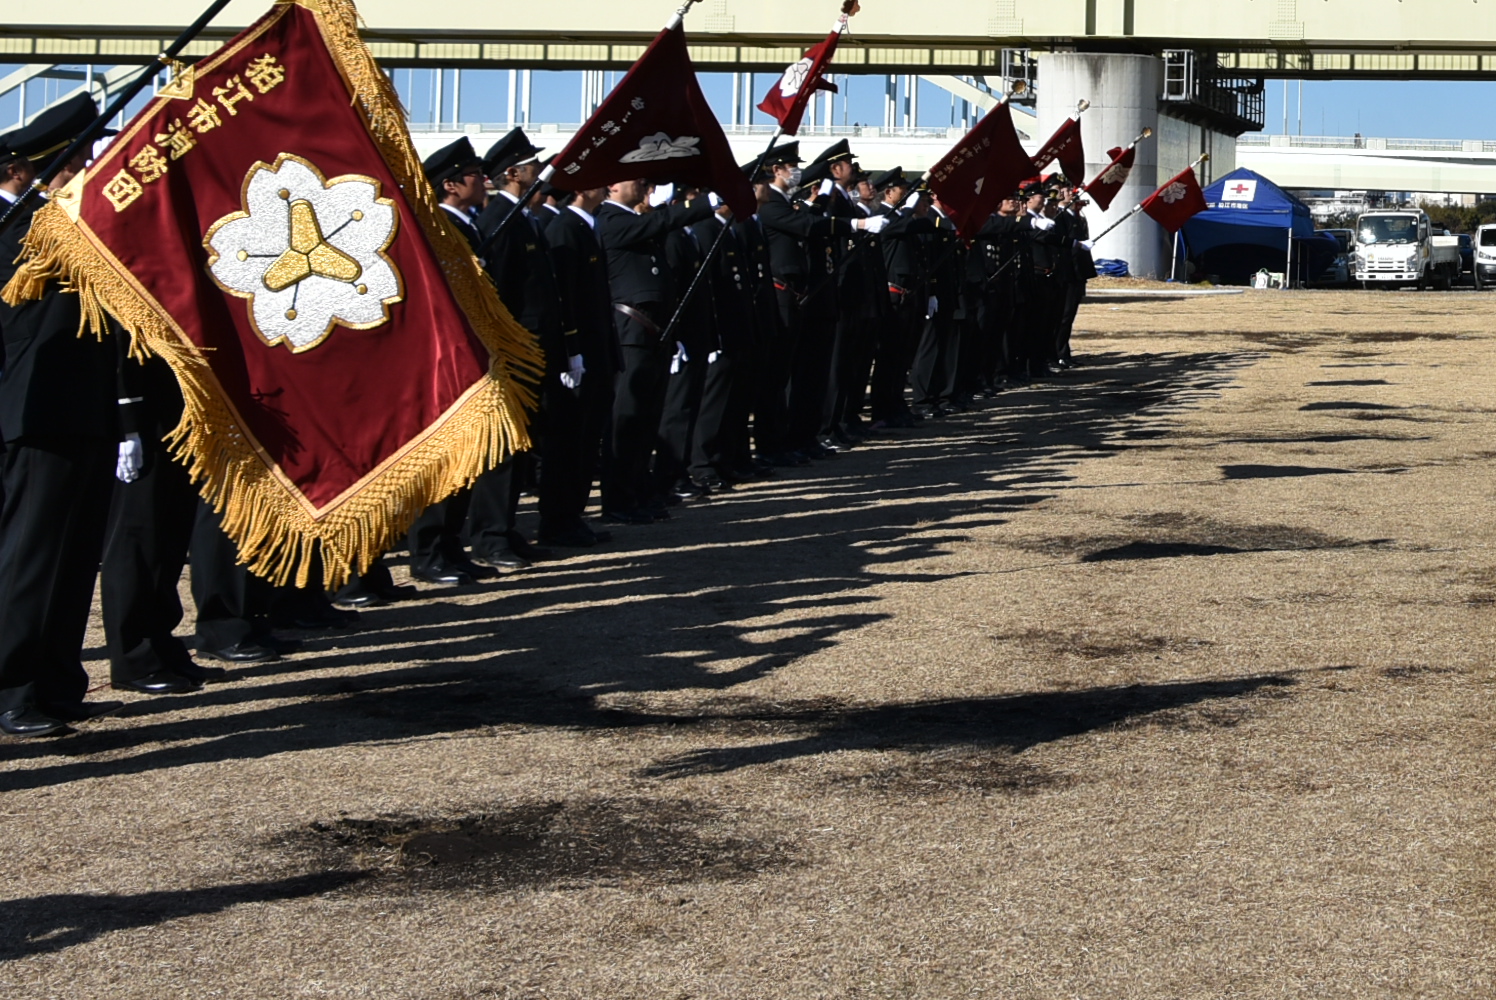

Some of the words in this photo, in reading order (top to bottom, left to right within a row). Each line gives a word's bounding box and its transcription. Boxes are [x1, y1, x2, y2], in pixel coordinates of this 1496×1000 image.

[102, 53, 285, 213] 狛江市消防団
